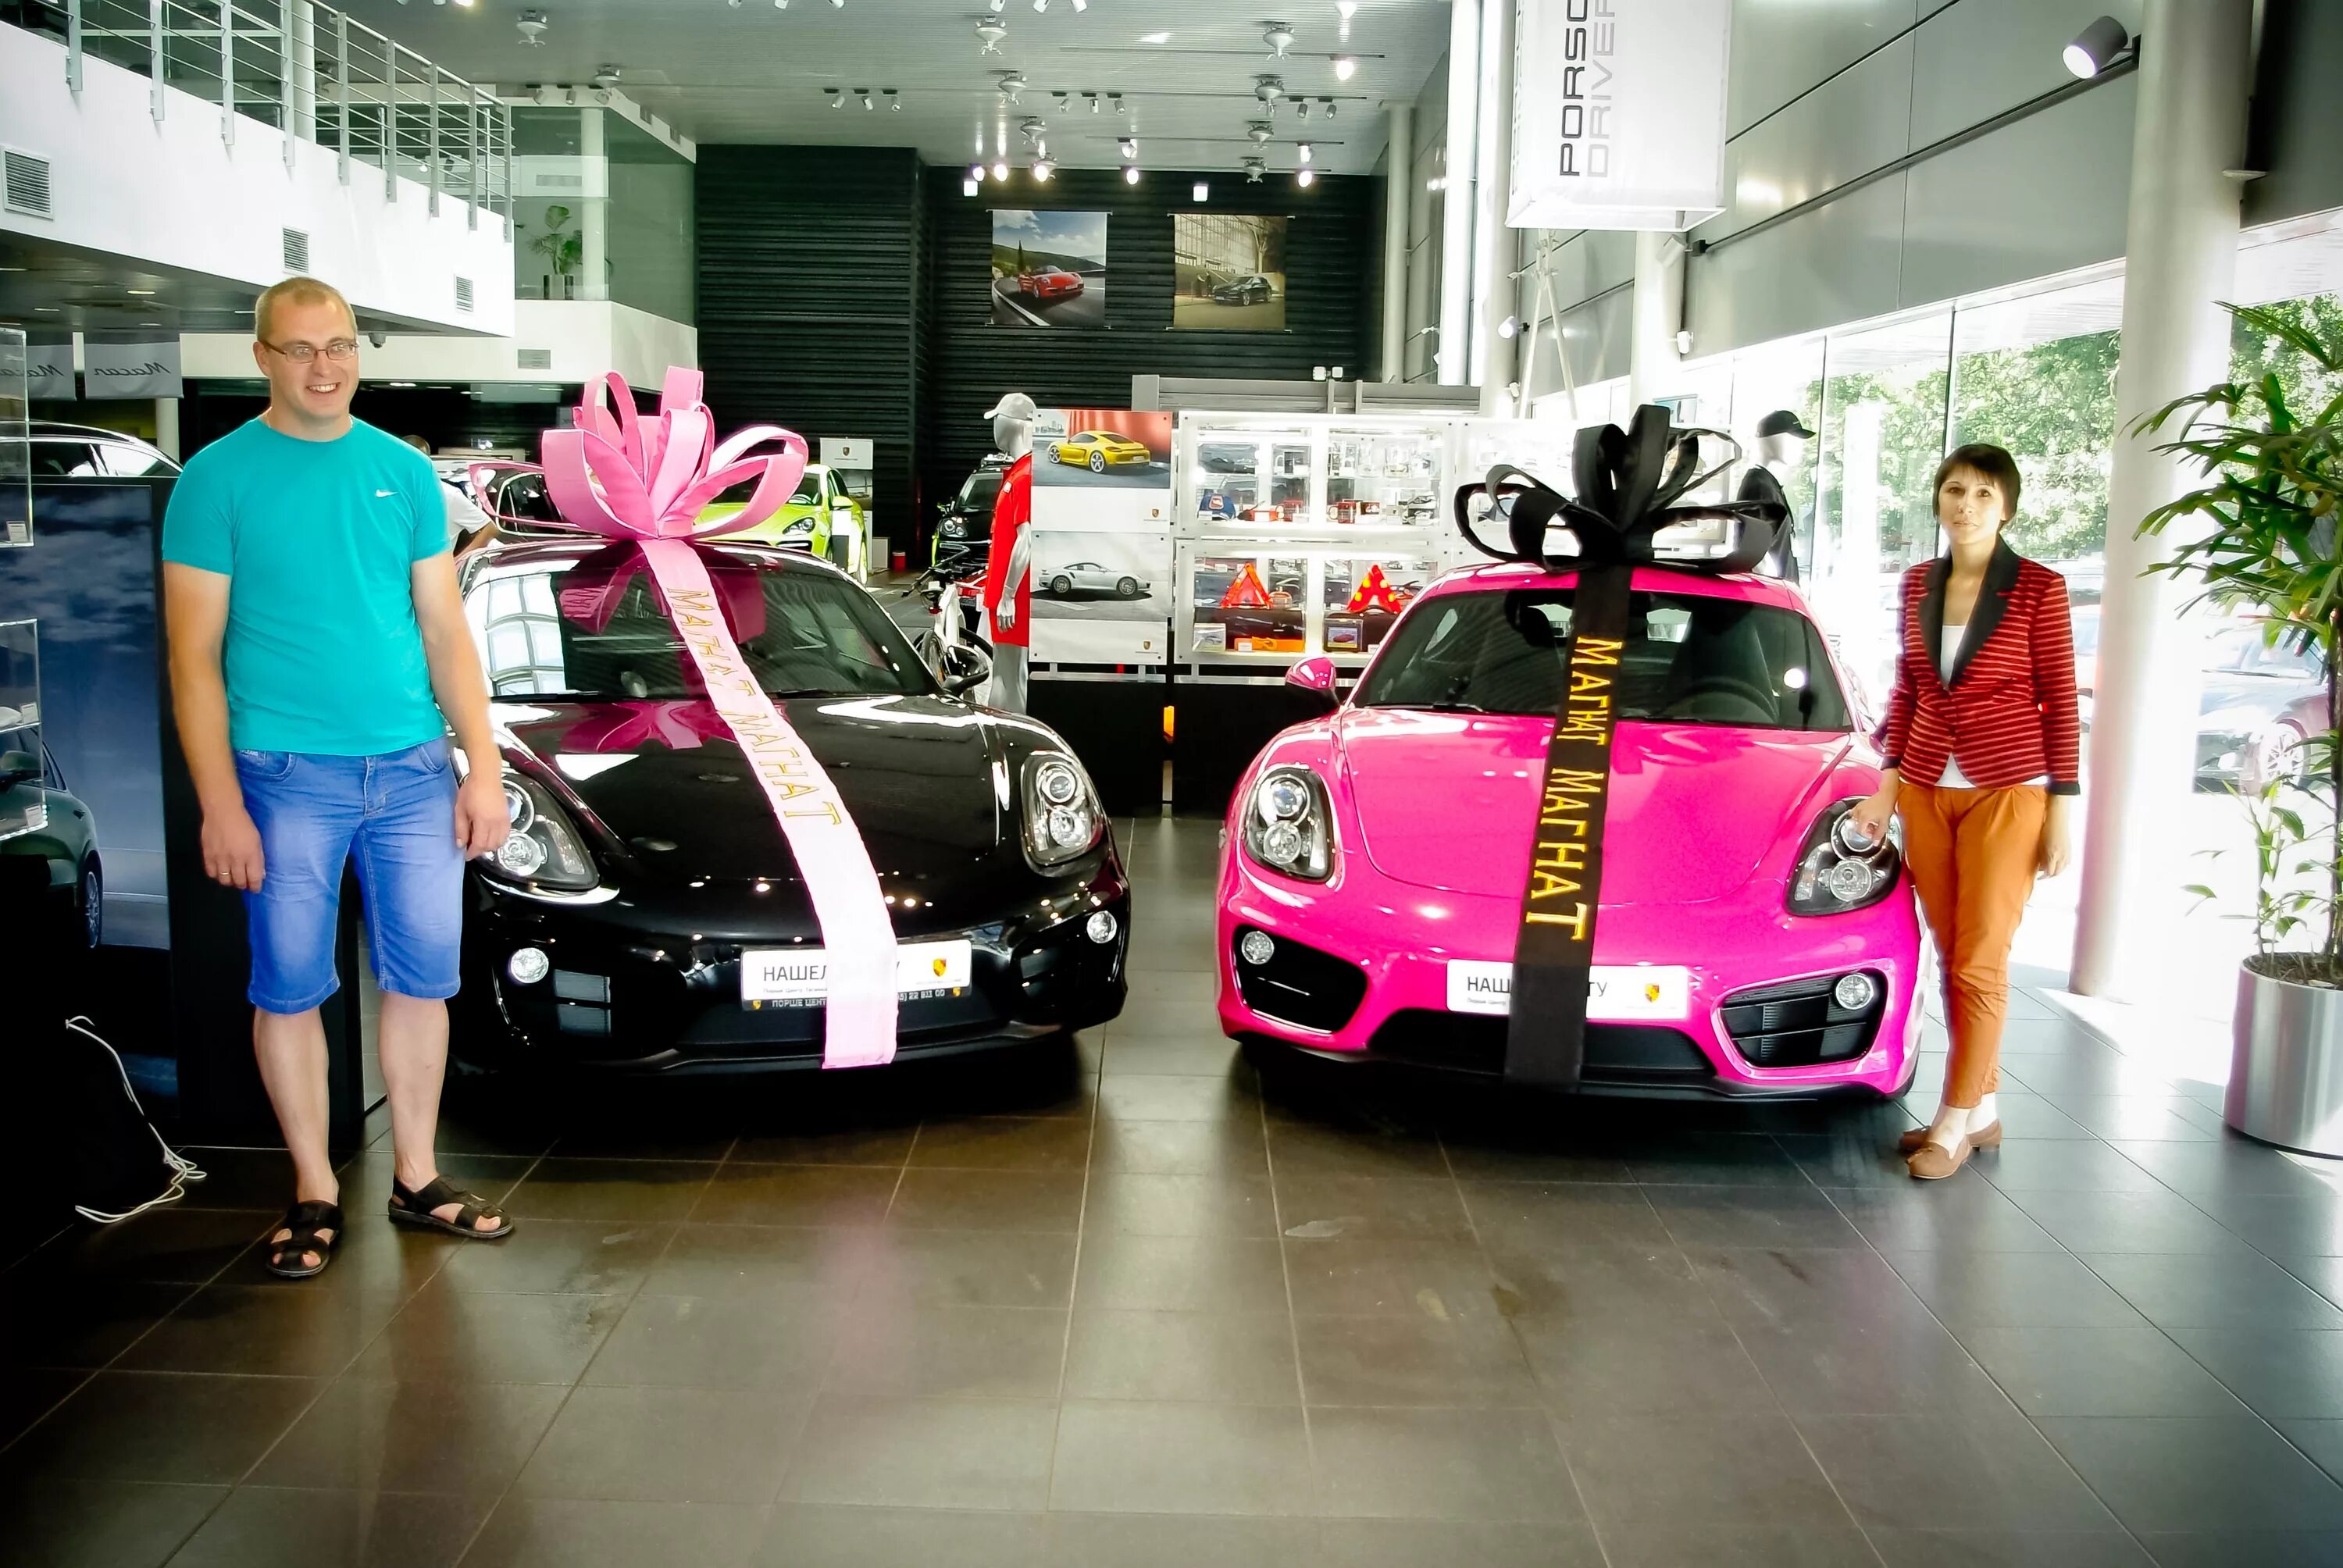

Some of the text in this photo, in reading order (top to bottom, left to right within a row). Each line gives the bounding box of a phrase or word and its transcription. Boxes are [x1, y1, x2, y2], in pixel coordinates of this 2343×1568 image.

[716, 709, 843, 825] МАГНАТ
[1525, 636, 1624, 942] МАГНАТ МАГНАТ
[772, 999, 803, 1008] ПОРШЕ
[908, 992, 918, 1000] 22
